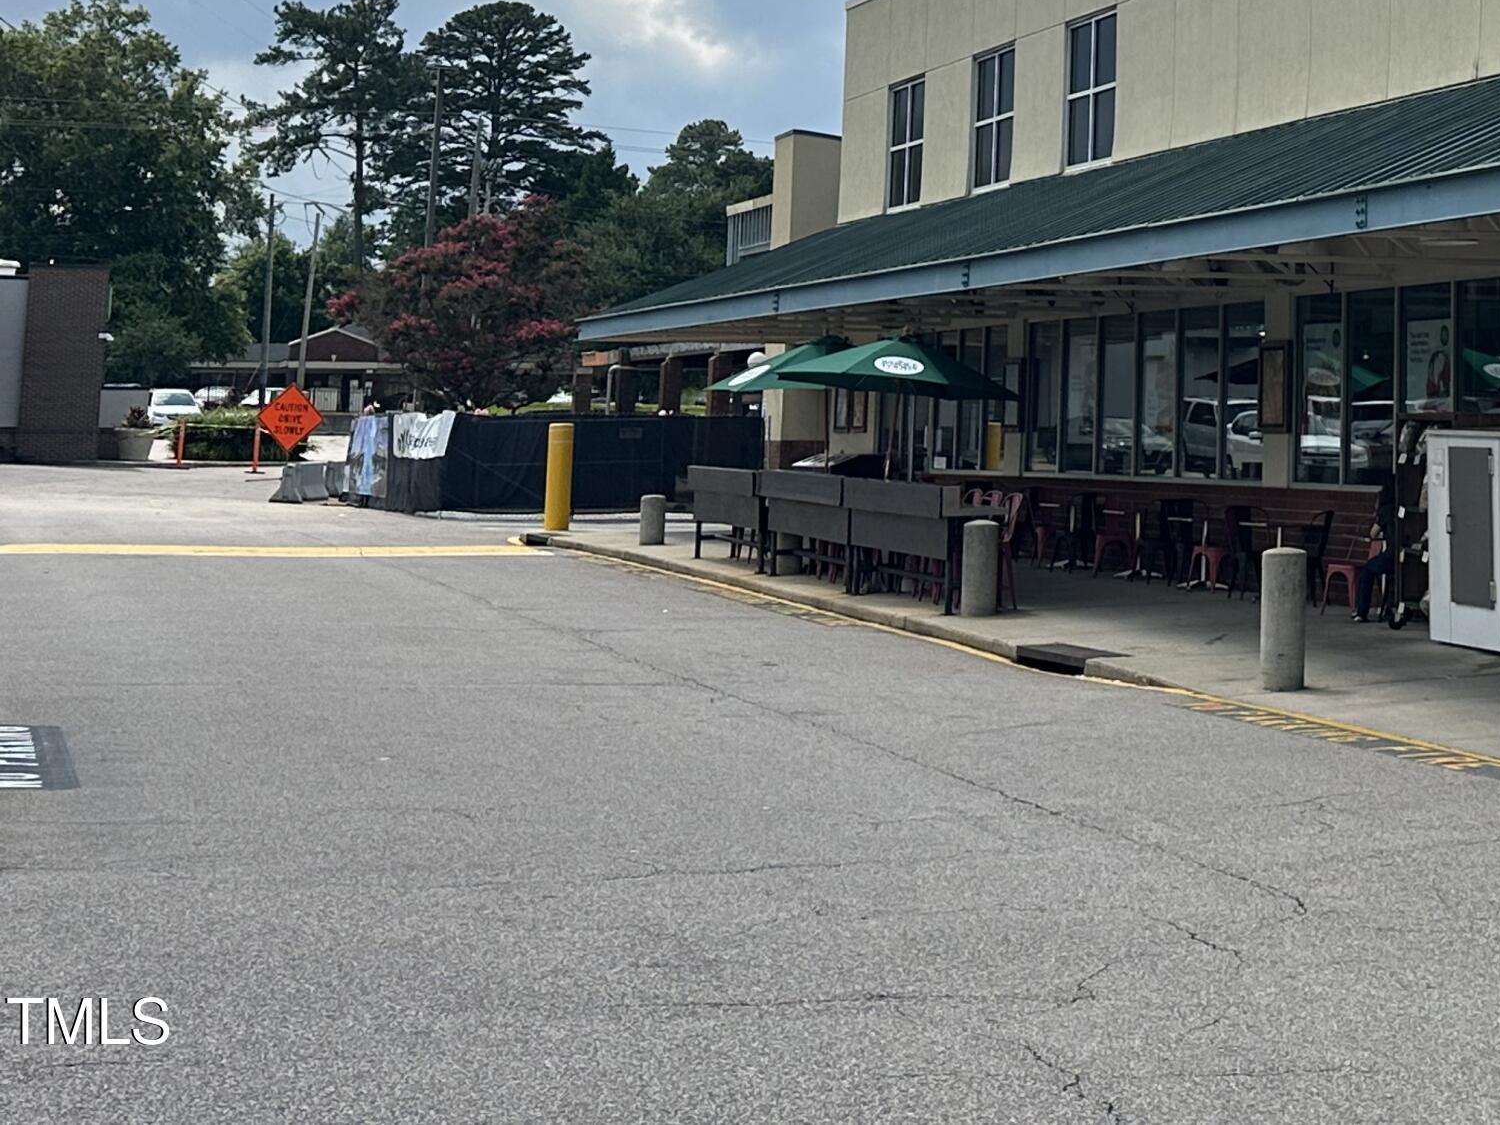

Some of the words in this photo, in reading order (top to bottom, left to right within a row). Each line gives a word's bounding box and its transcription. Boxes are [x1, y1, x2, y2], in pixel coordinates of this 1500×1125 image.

[274, 402, 309, 412] CAUTION
[278, 413, 303, 424] DRIVE
[273, 425, 304, 435] SLOWLY
